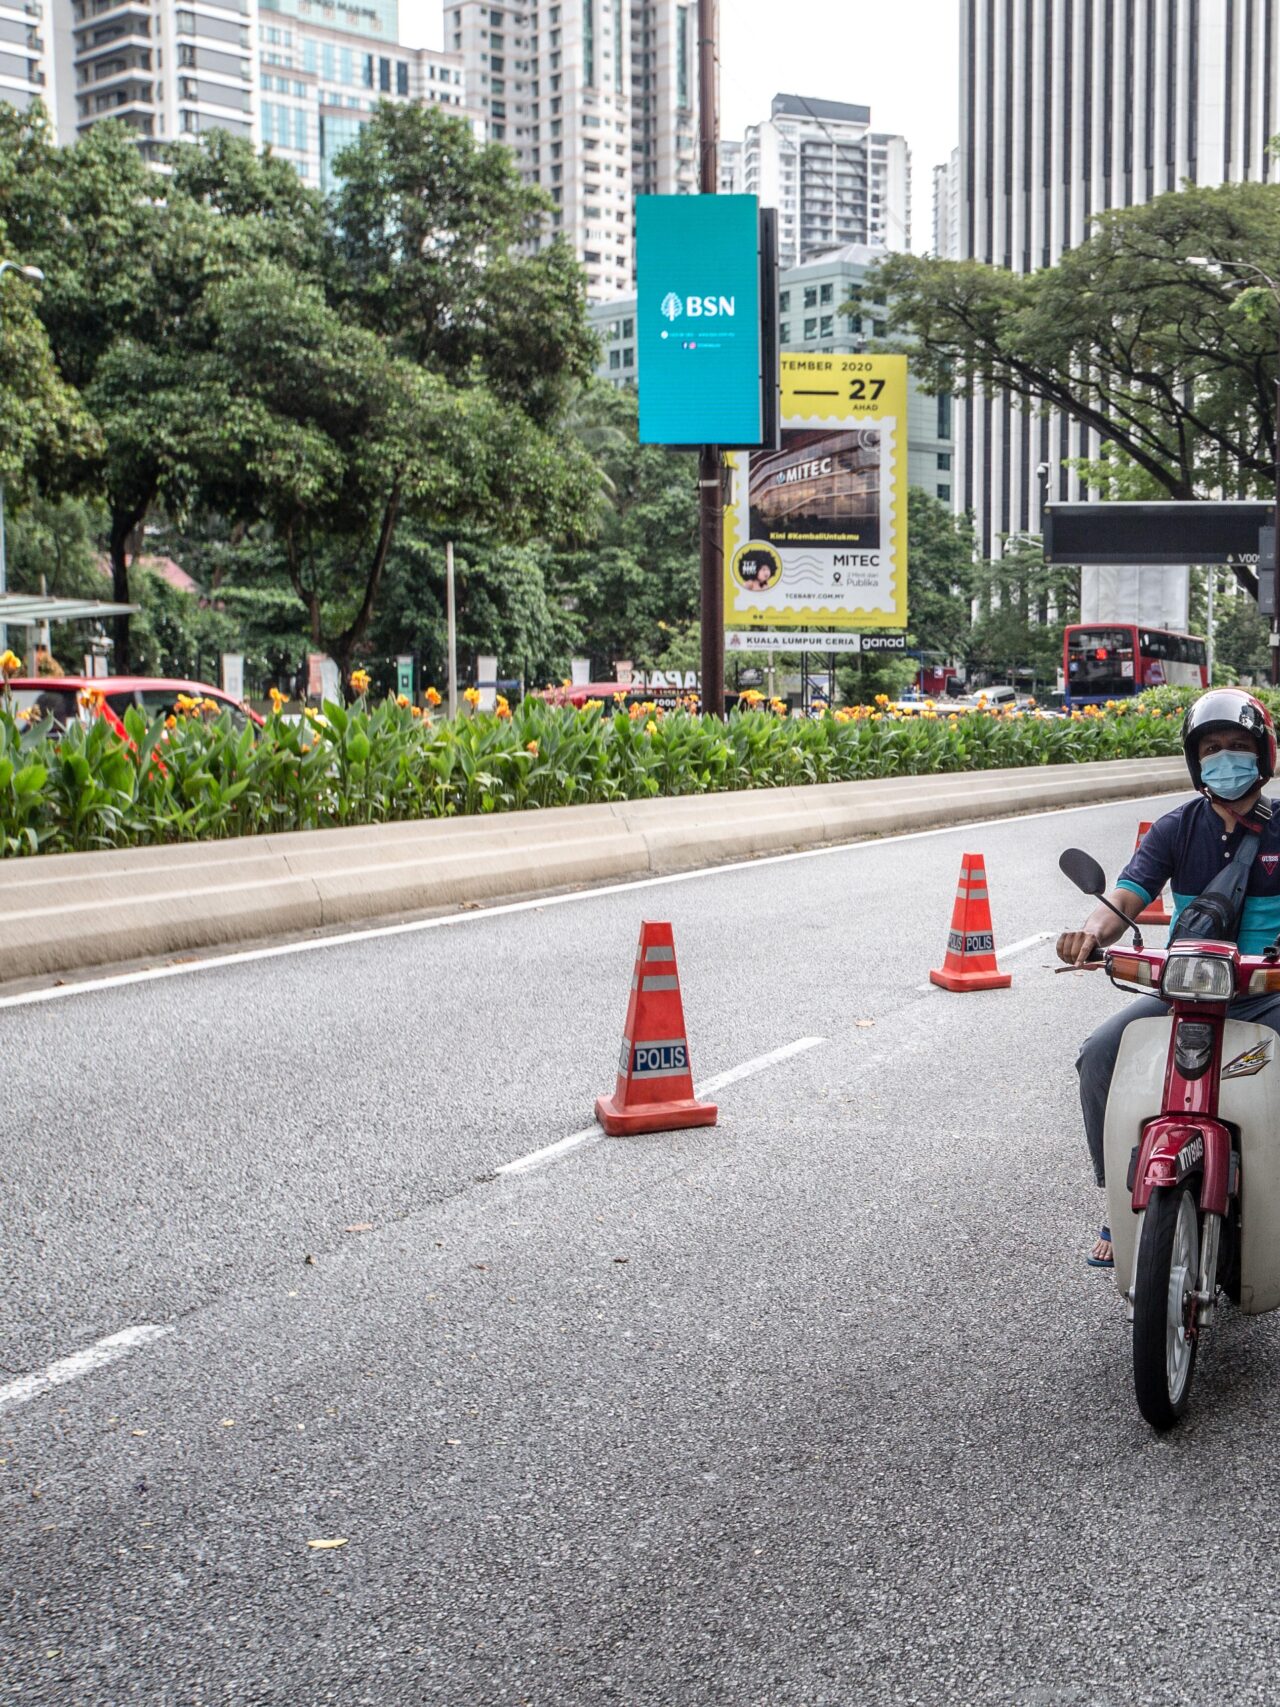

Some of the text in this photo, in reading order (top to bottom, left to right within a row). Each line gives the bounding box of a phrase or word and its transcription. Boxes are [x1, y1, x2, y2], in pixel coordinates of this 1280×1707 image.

[686, 296, 735, 317] BSN
[781, 361, 873, 372] TEMBER 2020
[849, 379, 886, 401] 27
[785, 457, 832, 483] MITEC
[769, 532, 786, 540] Kini
[833, 555, 880, 567] MITEC
[846, 578, 879, 587] Publika
[782, 637, 822, 645] LUMPUR
[862, 636, 905, 649] ganad
[966, 935, 992, 951] POLIS
[636, 1046, 685, 1070] POLIS
